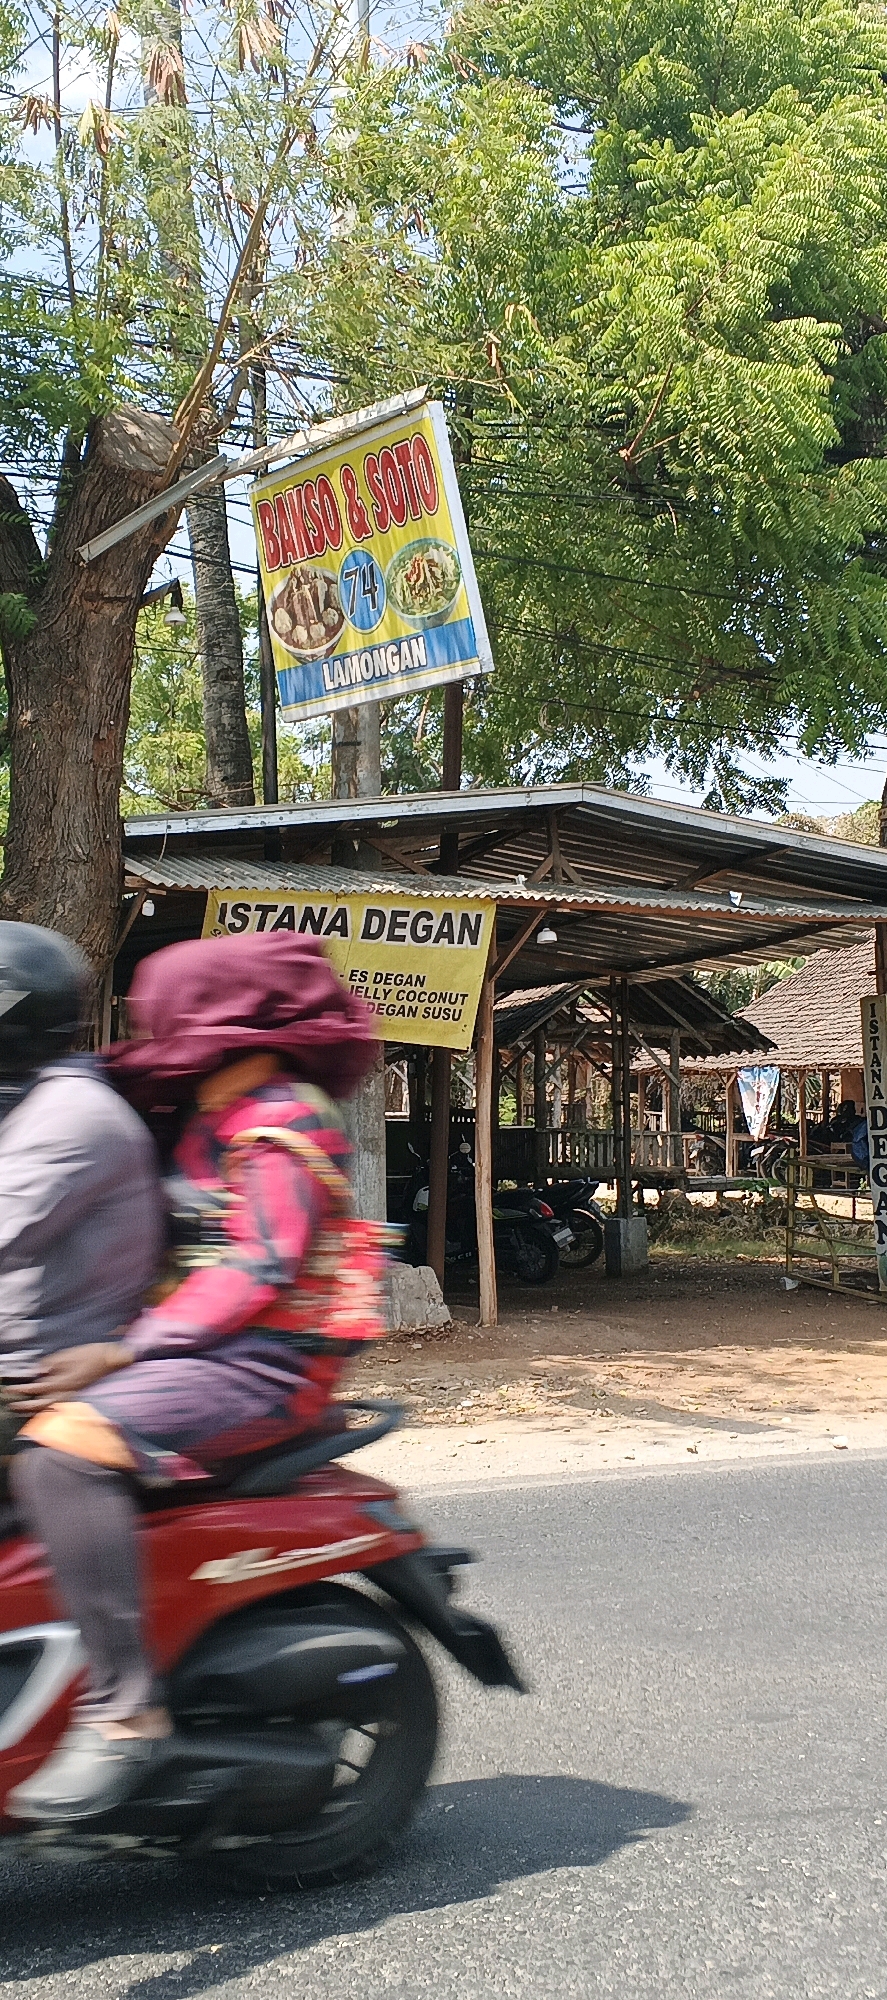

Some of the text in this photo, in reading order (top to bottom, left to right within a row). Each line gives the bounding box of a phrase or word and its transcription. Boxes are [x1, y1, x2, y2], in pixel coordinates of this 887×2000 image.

[257, 433, 439, 572] BAKSO & SOTO
[343, 561, 379, 619] 74
[322, 635, 427, 691] LAMONGAN
[218, 902, 482, 945] ISTANA DEGAN
[348, 969, 369, 983] ES
[372, 972, 426, 987] DEGAN
[396, 990, 468, 1005] COCONUT
[365, 1002, 462, 1021] DEGAN SUSU
[869, 1003, 884, 1100] ISTANA
